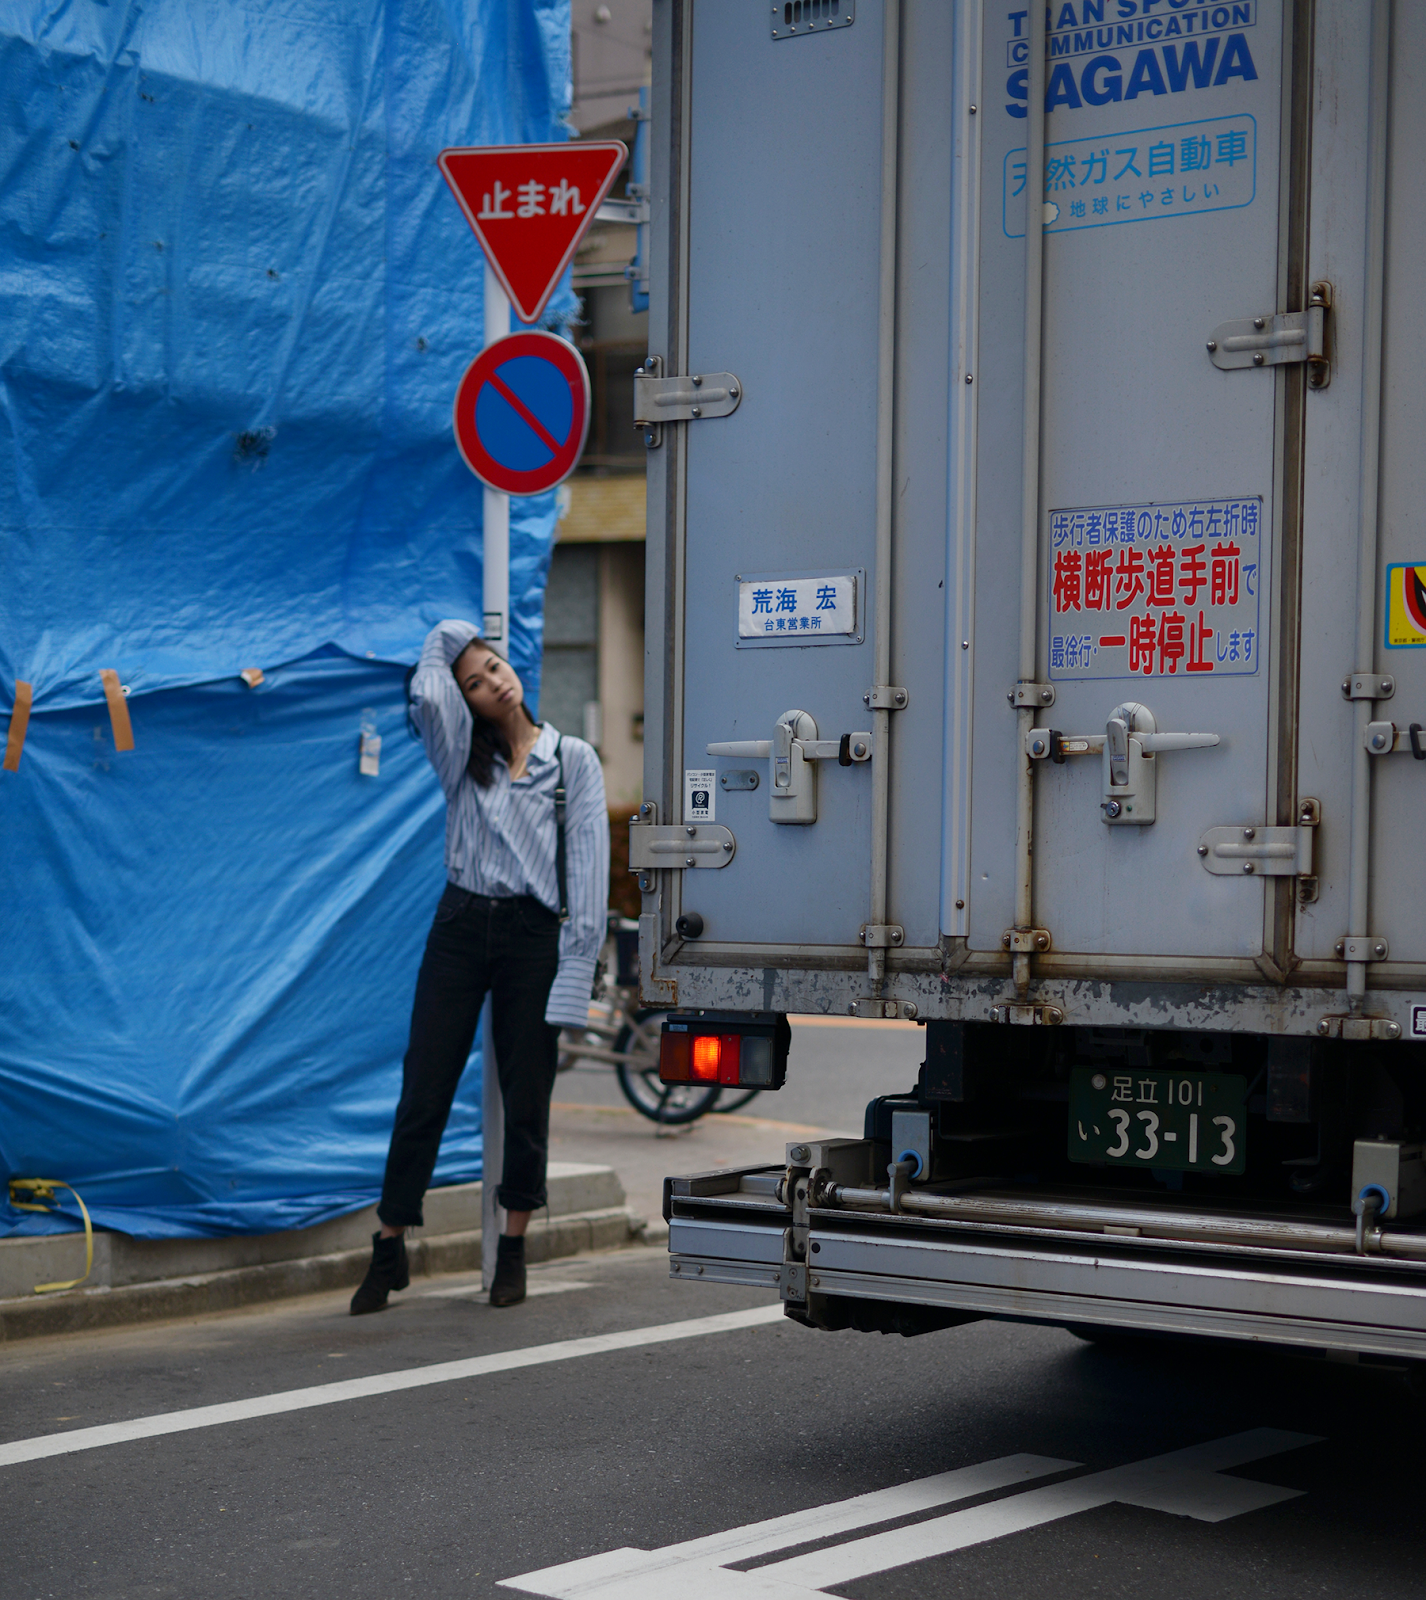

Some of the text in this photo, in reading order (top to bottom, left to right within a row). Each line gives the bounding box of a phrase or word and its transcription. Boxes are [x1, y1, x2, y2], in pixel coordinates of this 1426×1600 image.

[1012, 3, 1251, 62] CMMUNICATION
[1005, 33, 1258, 119] SAGAWA
[477, 177, 586, 220] 止まれ
[1069, 183, 1220, 218] 地球にやさしい
[1053, 502, 1258, 548] 歩行者保護のため右左折時
[1053, 540, 1258, 613] 横断歩道手前で
[752, 585, 837, 614] 荒海 宏
[764, 616, 822, 631] 台東営業所
[1111, 1076, 1203, 1106] 足立 101
[1078, 1108, 1236, 1165] い 33-13
